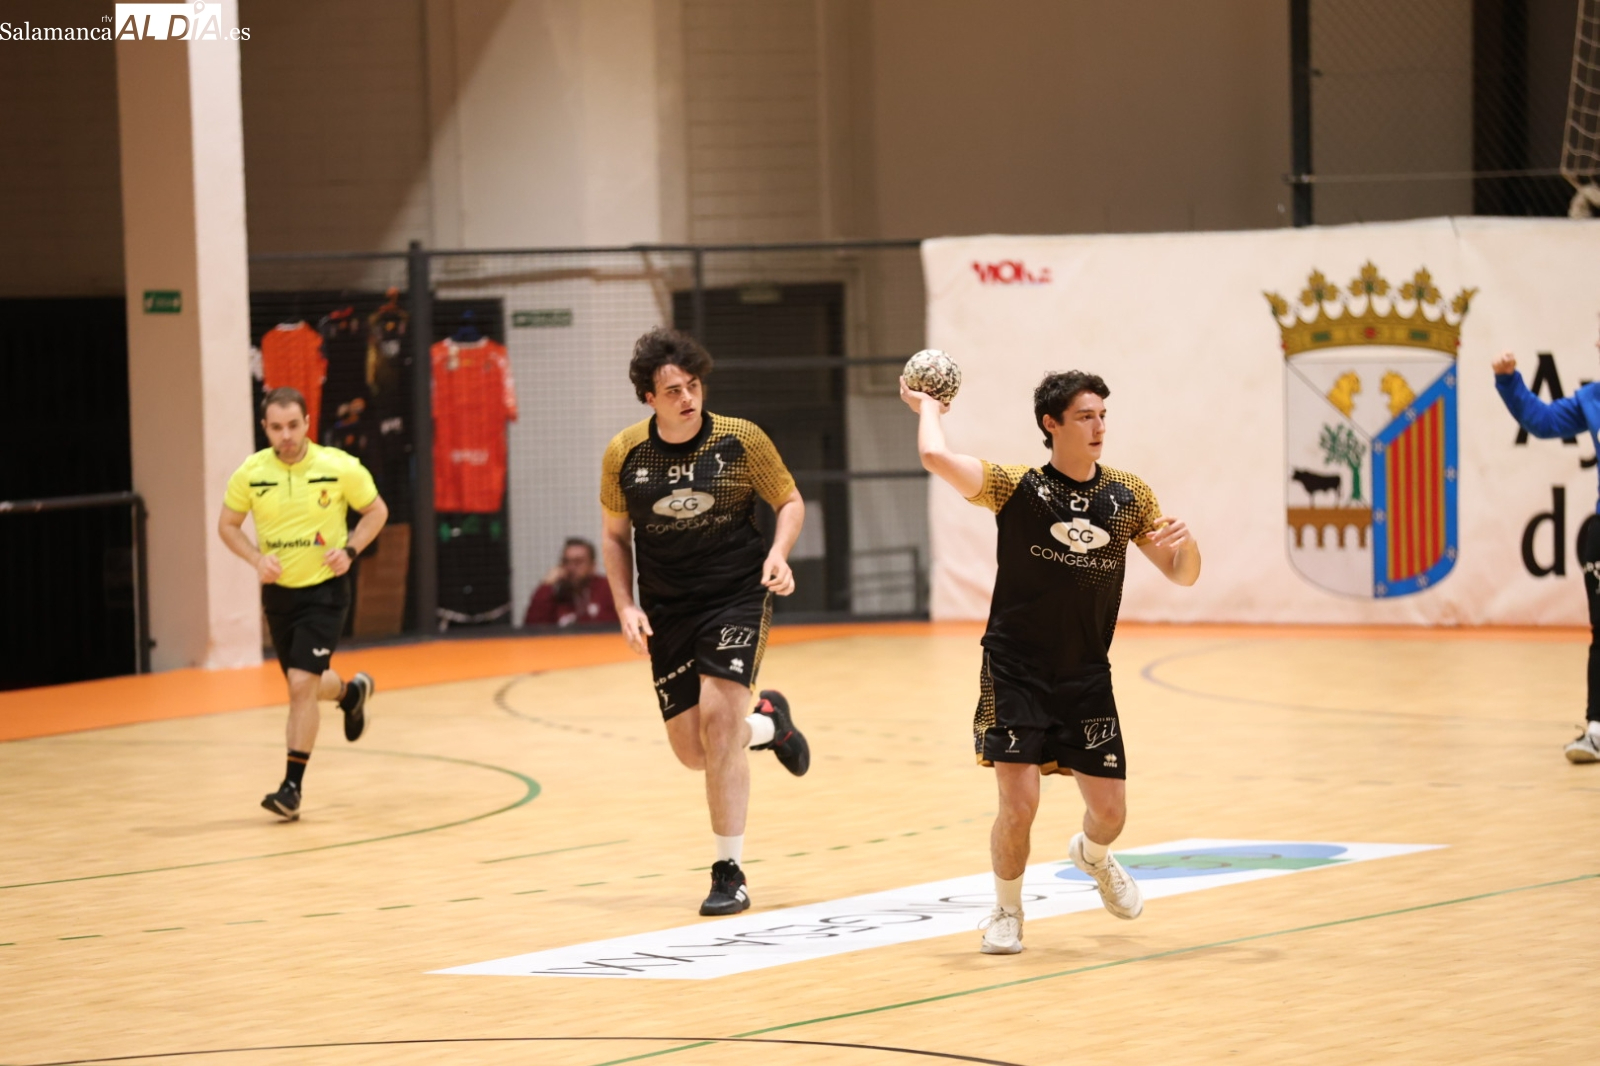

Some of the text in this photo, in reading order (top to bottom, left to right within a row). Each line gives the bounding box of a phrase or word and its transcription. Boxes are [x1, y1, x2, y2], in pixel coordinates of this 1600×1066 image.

[667, 463, 695, 484] 94
[669, 497, 699, 512] CG
[1070, 492, 1090, 513] 27
[646, 518, 710, 535] CONGESA
[1067, 528, 1094, 544] CG
[1030, 545, 1118, 570] CONGESA XXI
[717, 626, 756, 651] Gil
[1083, 719, 1118, 750] Gil
